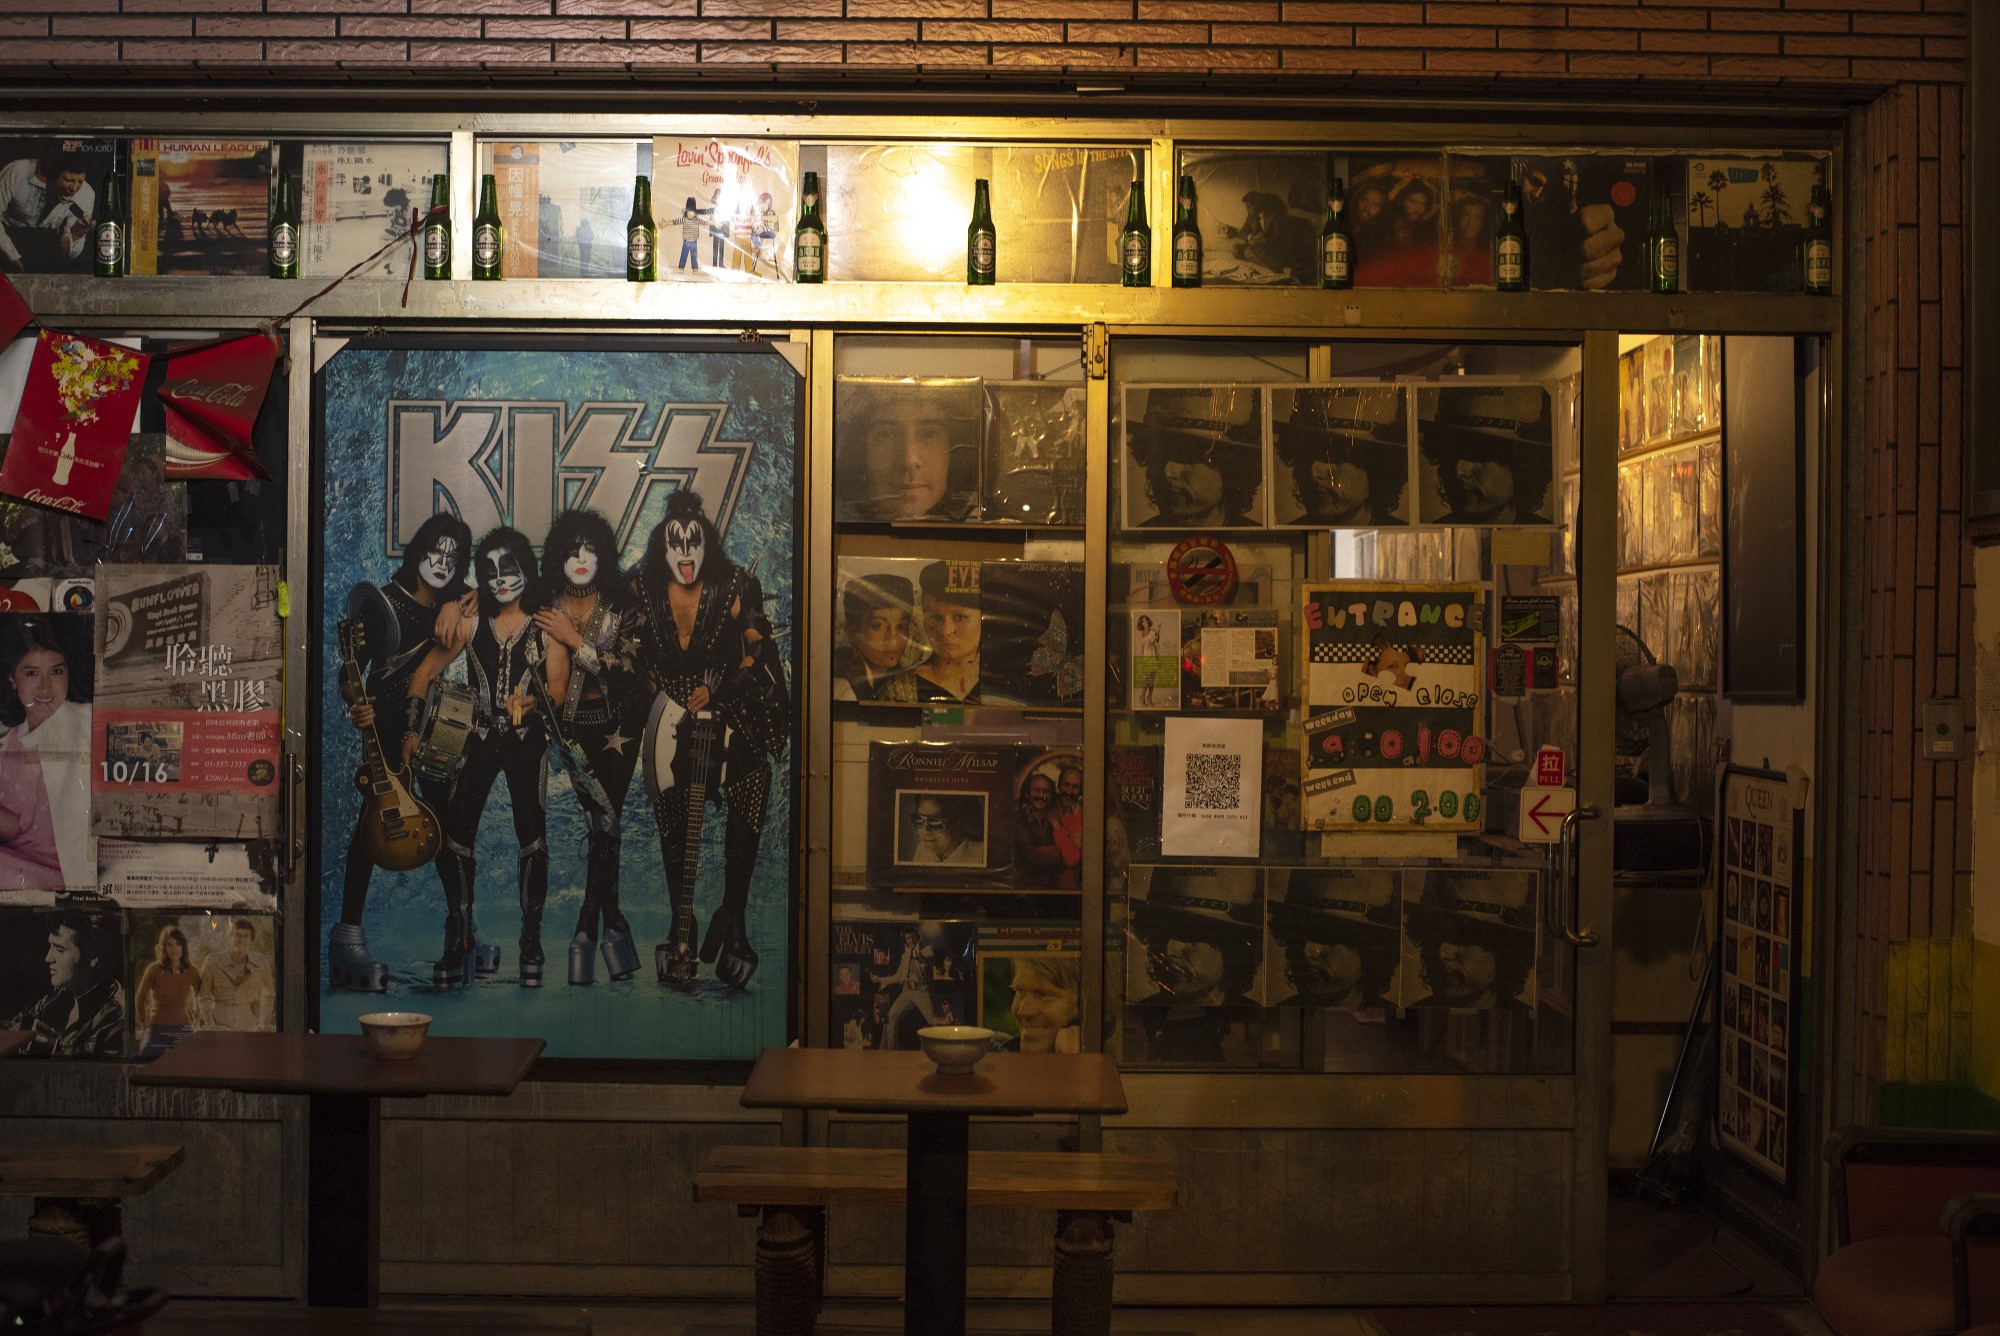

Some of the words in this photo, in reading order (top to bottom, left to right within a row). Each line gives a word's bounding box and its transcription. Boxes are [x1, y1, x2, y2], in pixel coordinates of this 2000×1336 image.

[163, 144, 211, 152] HUMAN
[213, 144, 263, 152] LEAGUE
[676, 142, 708, 167] Lovin'
[1034, 151, 1075, 174] SONGS
[1089, 150, 1107, 162] THE
[508, 167, 524, 217] 因幡晃
[171, 379, 255, 407] Coca-Cola
[384, 400, 754, 557] KISS
[948, 566, 981, 587] EVE
[1303, 599, 1484, 632] ENTRANCE
[165, 643, 234, 677] 聆聽
[197, 679, 265, 713] 黑膠
[1304, 709, 1353, 730] weekday
[99, 761, 168, 785] 10/16
[1542, 754, 1560, 772] 拉
[1305, 772, 1352, 792] weekend
[1539, 775, 1561, 784] PULL
[1745, 784, 1774, 819] QUEEN
[835, 925, 854, 934] THE
[839, 934, 874, 945] ELVIS
